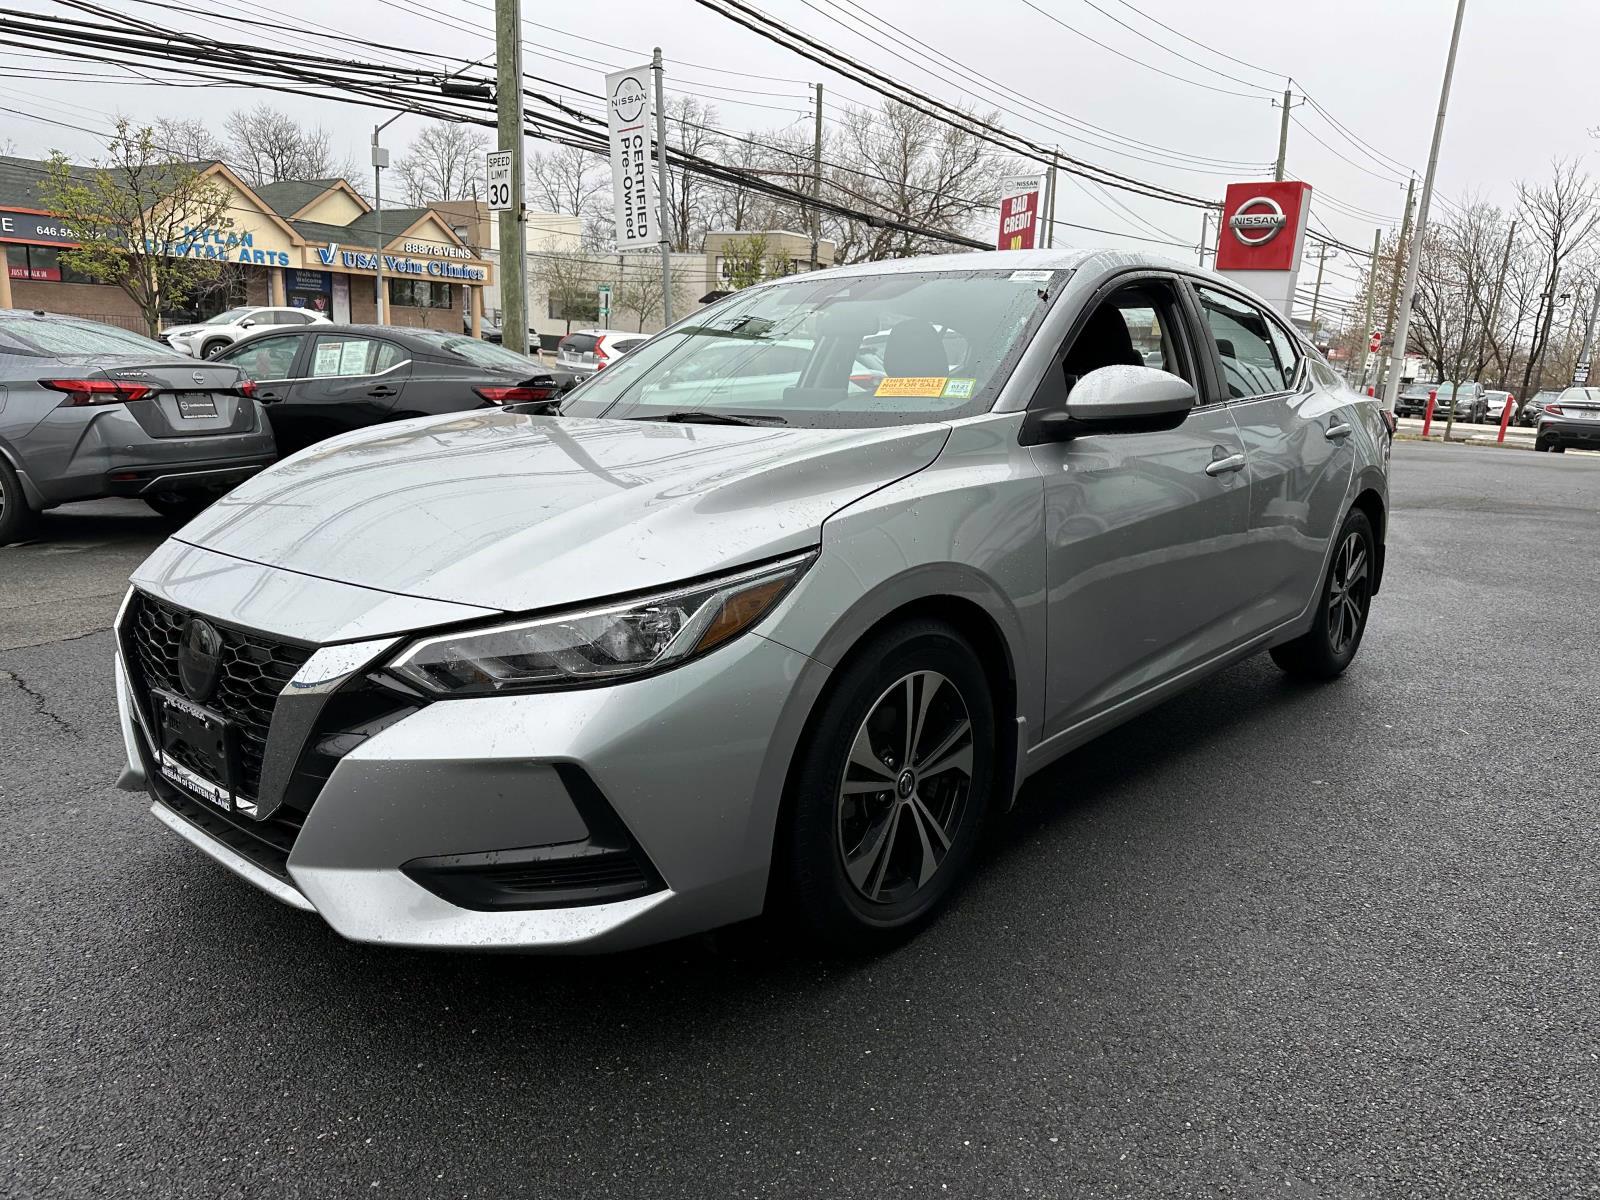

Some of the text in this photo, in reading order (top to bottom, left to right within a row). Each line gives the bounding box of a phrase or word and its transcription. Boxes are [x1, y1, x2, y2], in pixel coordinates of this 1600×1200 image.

[612, 93, 647, 107] NISSAN
[489, 157, 510, 167] SPEED
[491, 169, 507, 180] LIMIT
[490, 184, 509, 205] 30
[621, 138, 636, 240] Pre-Owned
[633, 135, 648, 238] CERTIFIED
[1011, 195, 1028, 215] BAD
[1004, 211, 1032, 234] CREDIT
[1234, 216, 1279, 225] NISSAN
[239, 248, 290, 267] ARTS
[385, 255, 423, 275] Vein
[428, 261, 485, 280] Clinics
[188, 781, 210, 800] STATEN
